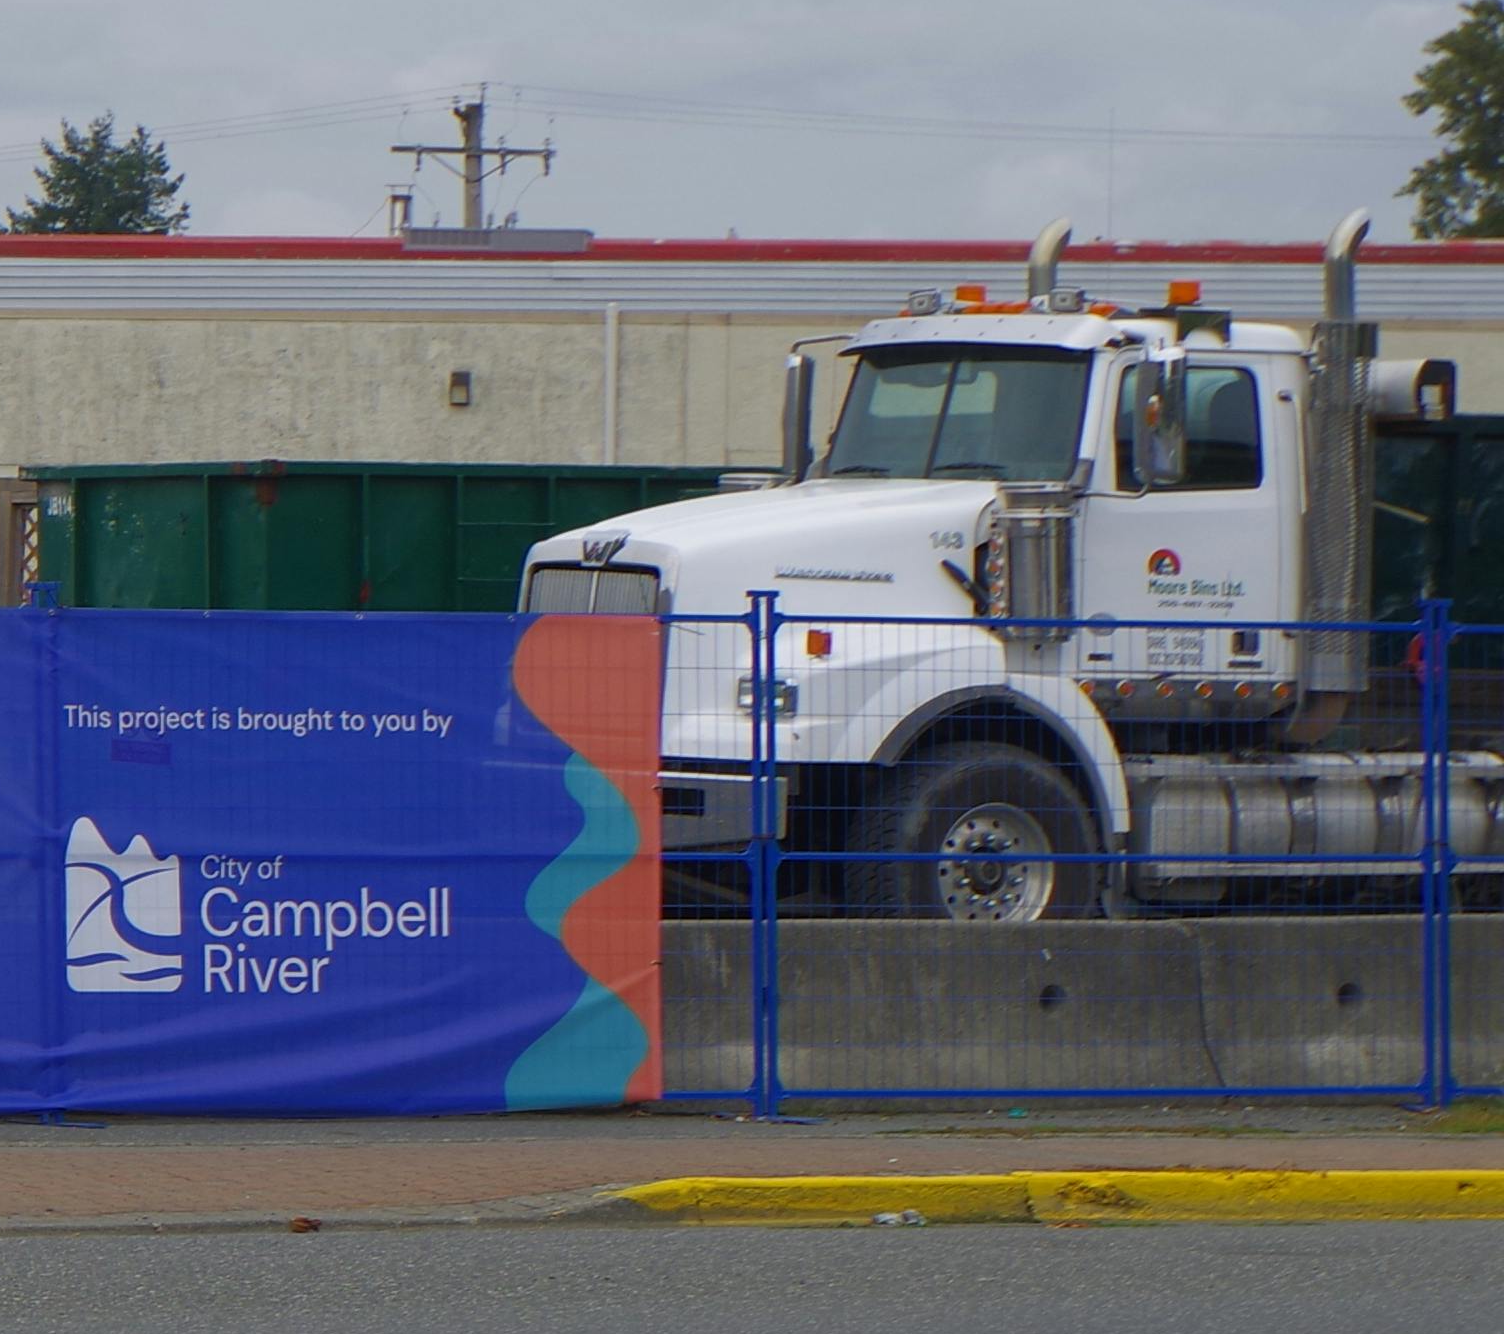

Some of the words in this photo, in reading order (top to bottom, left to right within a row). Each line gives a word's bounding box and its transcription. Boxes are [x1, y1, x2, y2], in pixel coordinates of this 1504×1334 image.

[1146, 579, 1188, 596] Moore
[1191, 579, 1219, 597] Bins
[63, 705, 112, 729] This
[118, 705, 205, 736] project
[211, 707, 231, 731] is
[237, 707, 334, 738] brought
[340, 710, 365, 732] to
[372, 712, 416, 738] you
[422, 708, 453, 738] by
[200, 854, 252, 886] City
[257, 854, 283, 880] of
[200, 886, 450, 952] Campbell
[203, 943, 330, 994] River
